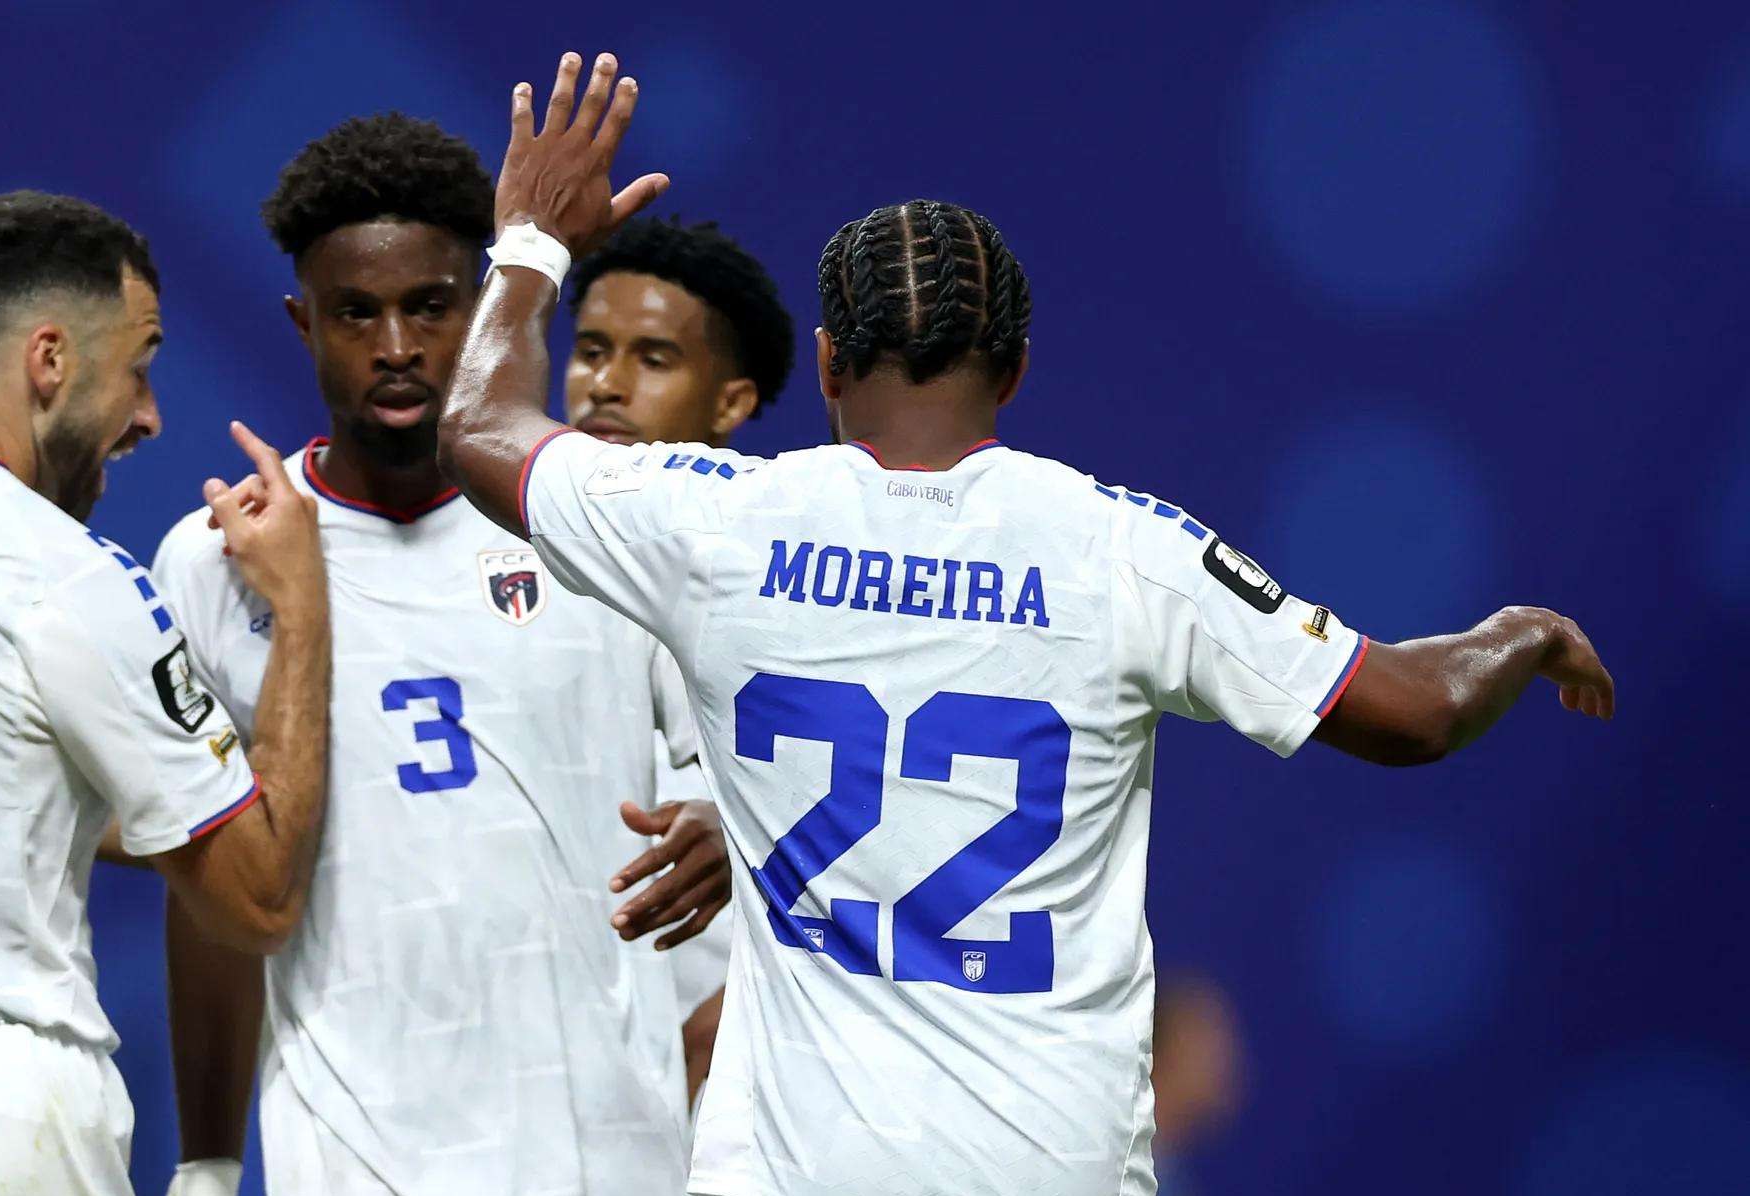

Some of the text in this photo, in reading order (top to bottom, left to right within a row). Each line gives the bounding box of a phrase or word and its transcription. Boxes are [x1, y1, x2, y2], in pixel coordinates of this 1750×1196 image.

[759, 539, 1051, 628] MOREIRA
[381, 676, 478, 794] 3
[734, 672, 1072, 995] 22
